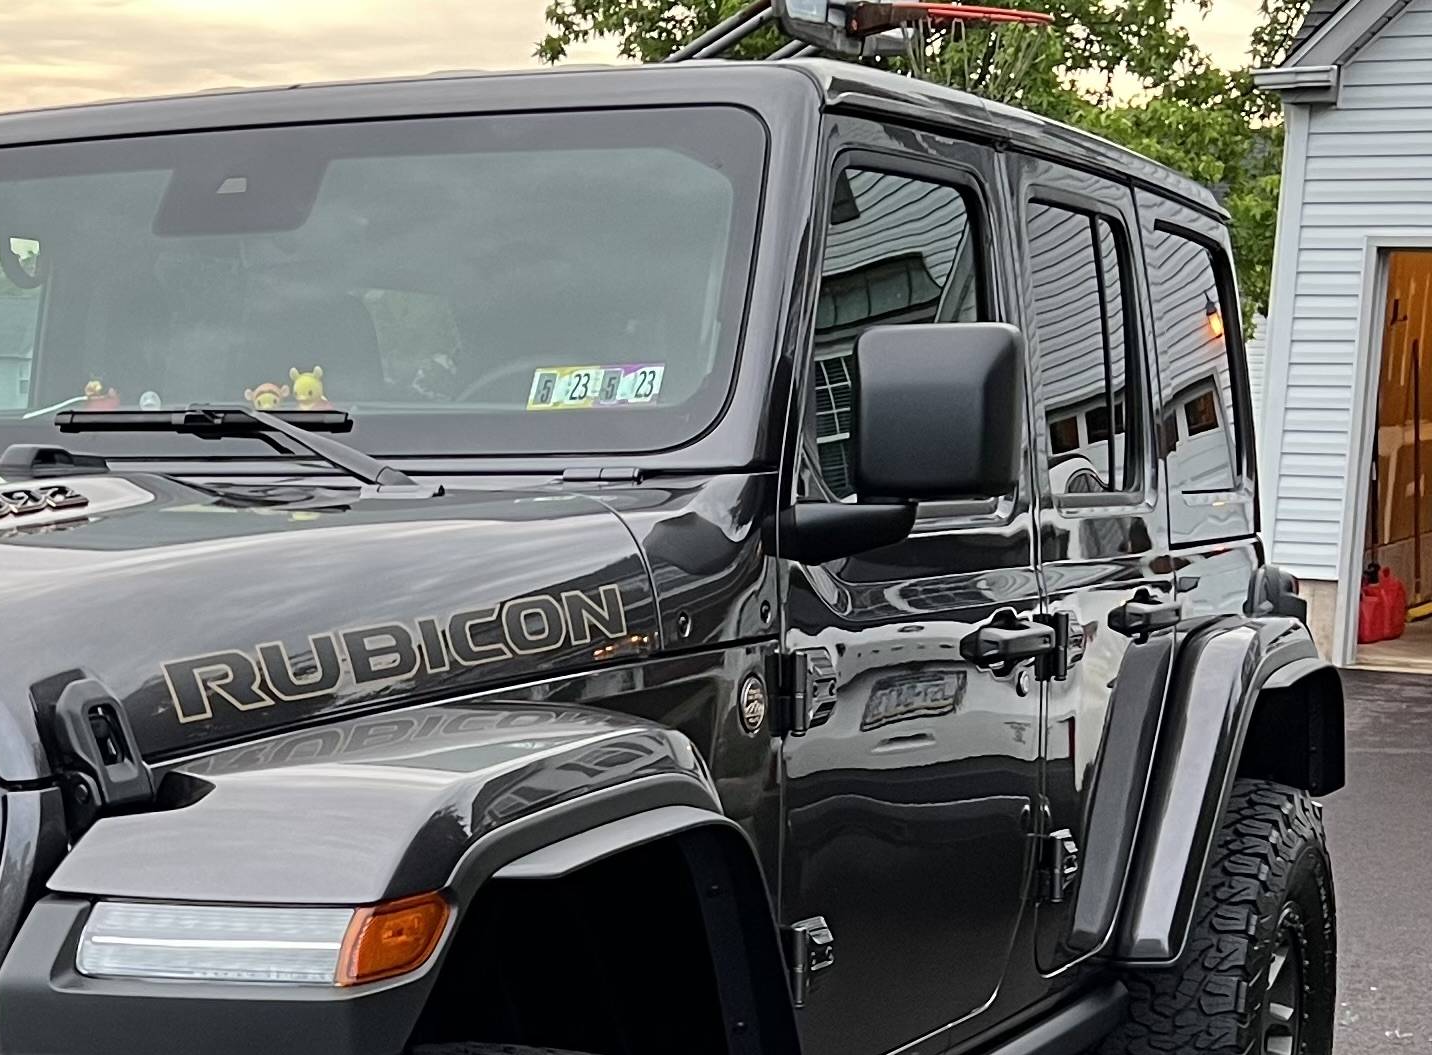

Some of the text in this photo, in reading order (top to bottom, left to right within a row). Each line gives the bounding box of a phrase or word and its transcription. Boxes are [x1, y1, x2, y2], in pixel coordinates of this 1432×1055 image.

[540, 373, 591, 404] 5 23
[604, 370, 657, 400] 5 23
[160, 584, 628, 724] RUBICON
